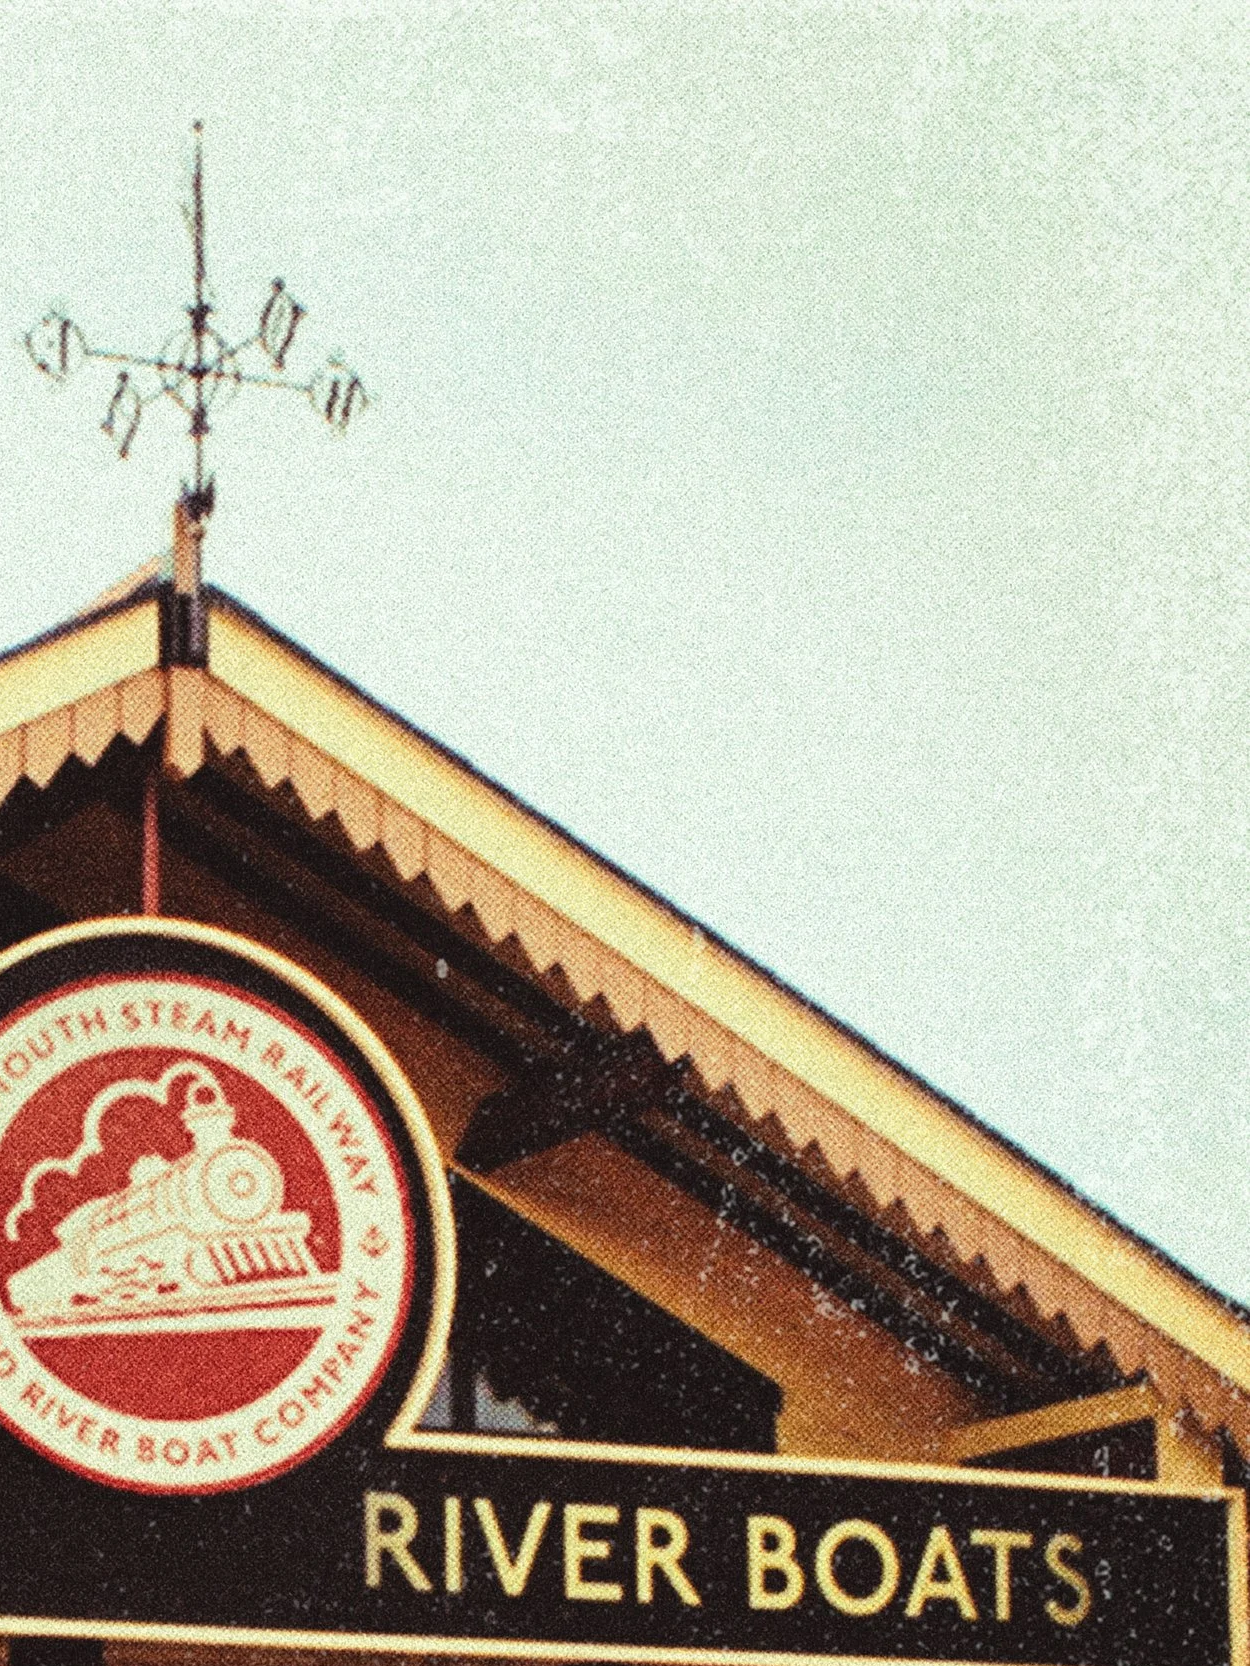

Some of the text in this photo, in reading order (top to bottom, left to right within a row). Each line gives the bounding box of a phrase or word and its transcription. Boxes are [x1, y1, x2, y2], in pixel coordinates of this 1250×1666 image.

[120, 1000, 252, 1051] STEAM
[260, 1040, 378, 1194] RAILWAY
[19, 1382, 120, 1456] RIVER
[137, 1431, 238, 1466] BOAT
[253, 1279, 381, 1445] COMPANY
[363, 1491, 702, 1608] RIVER
[747, 1514, 1091, 1627] BOATS
